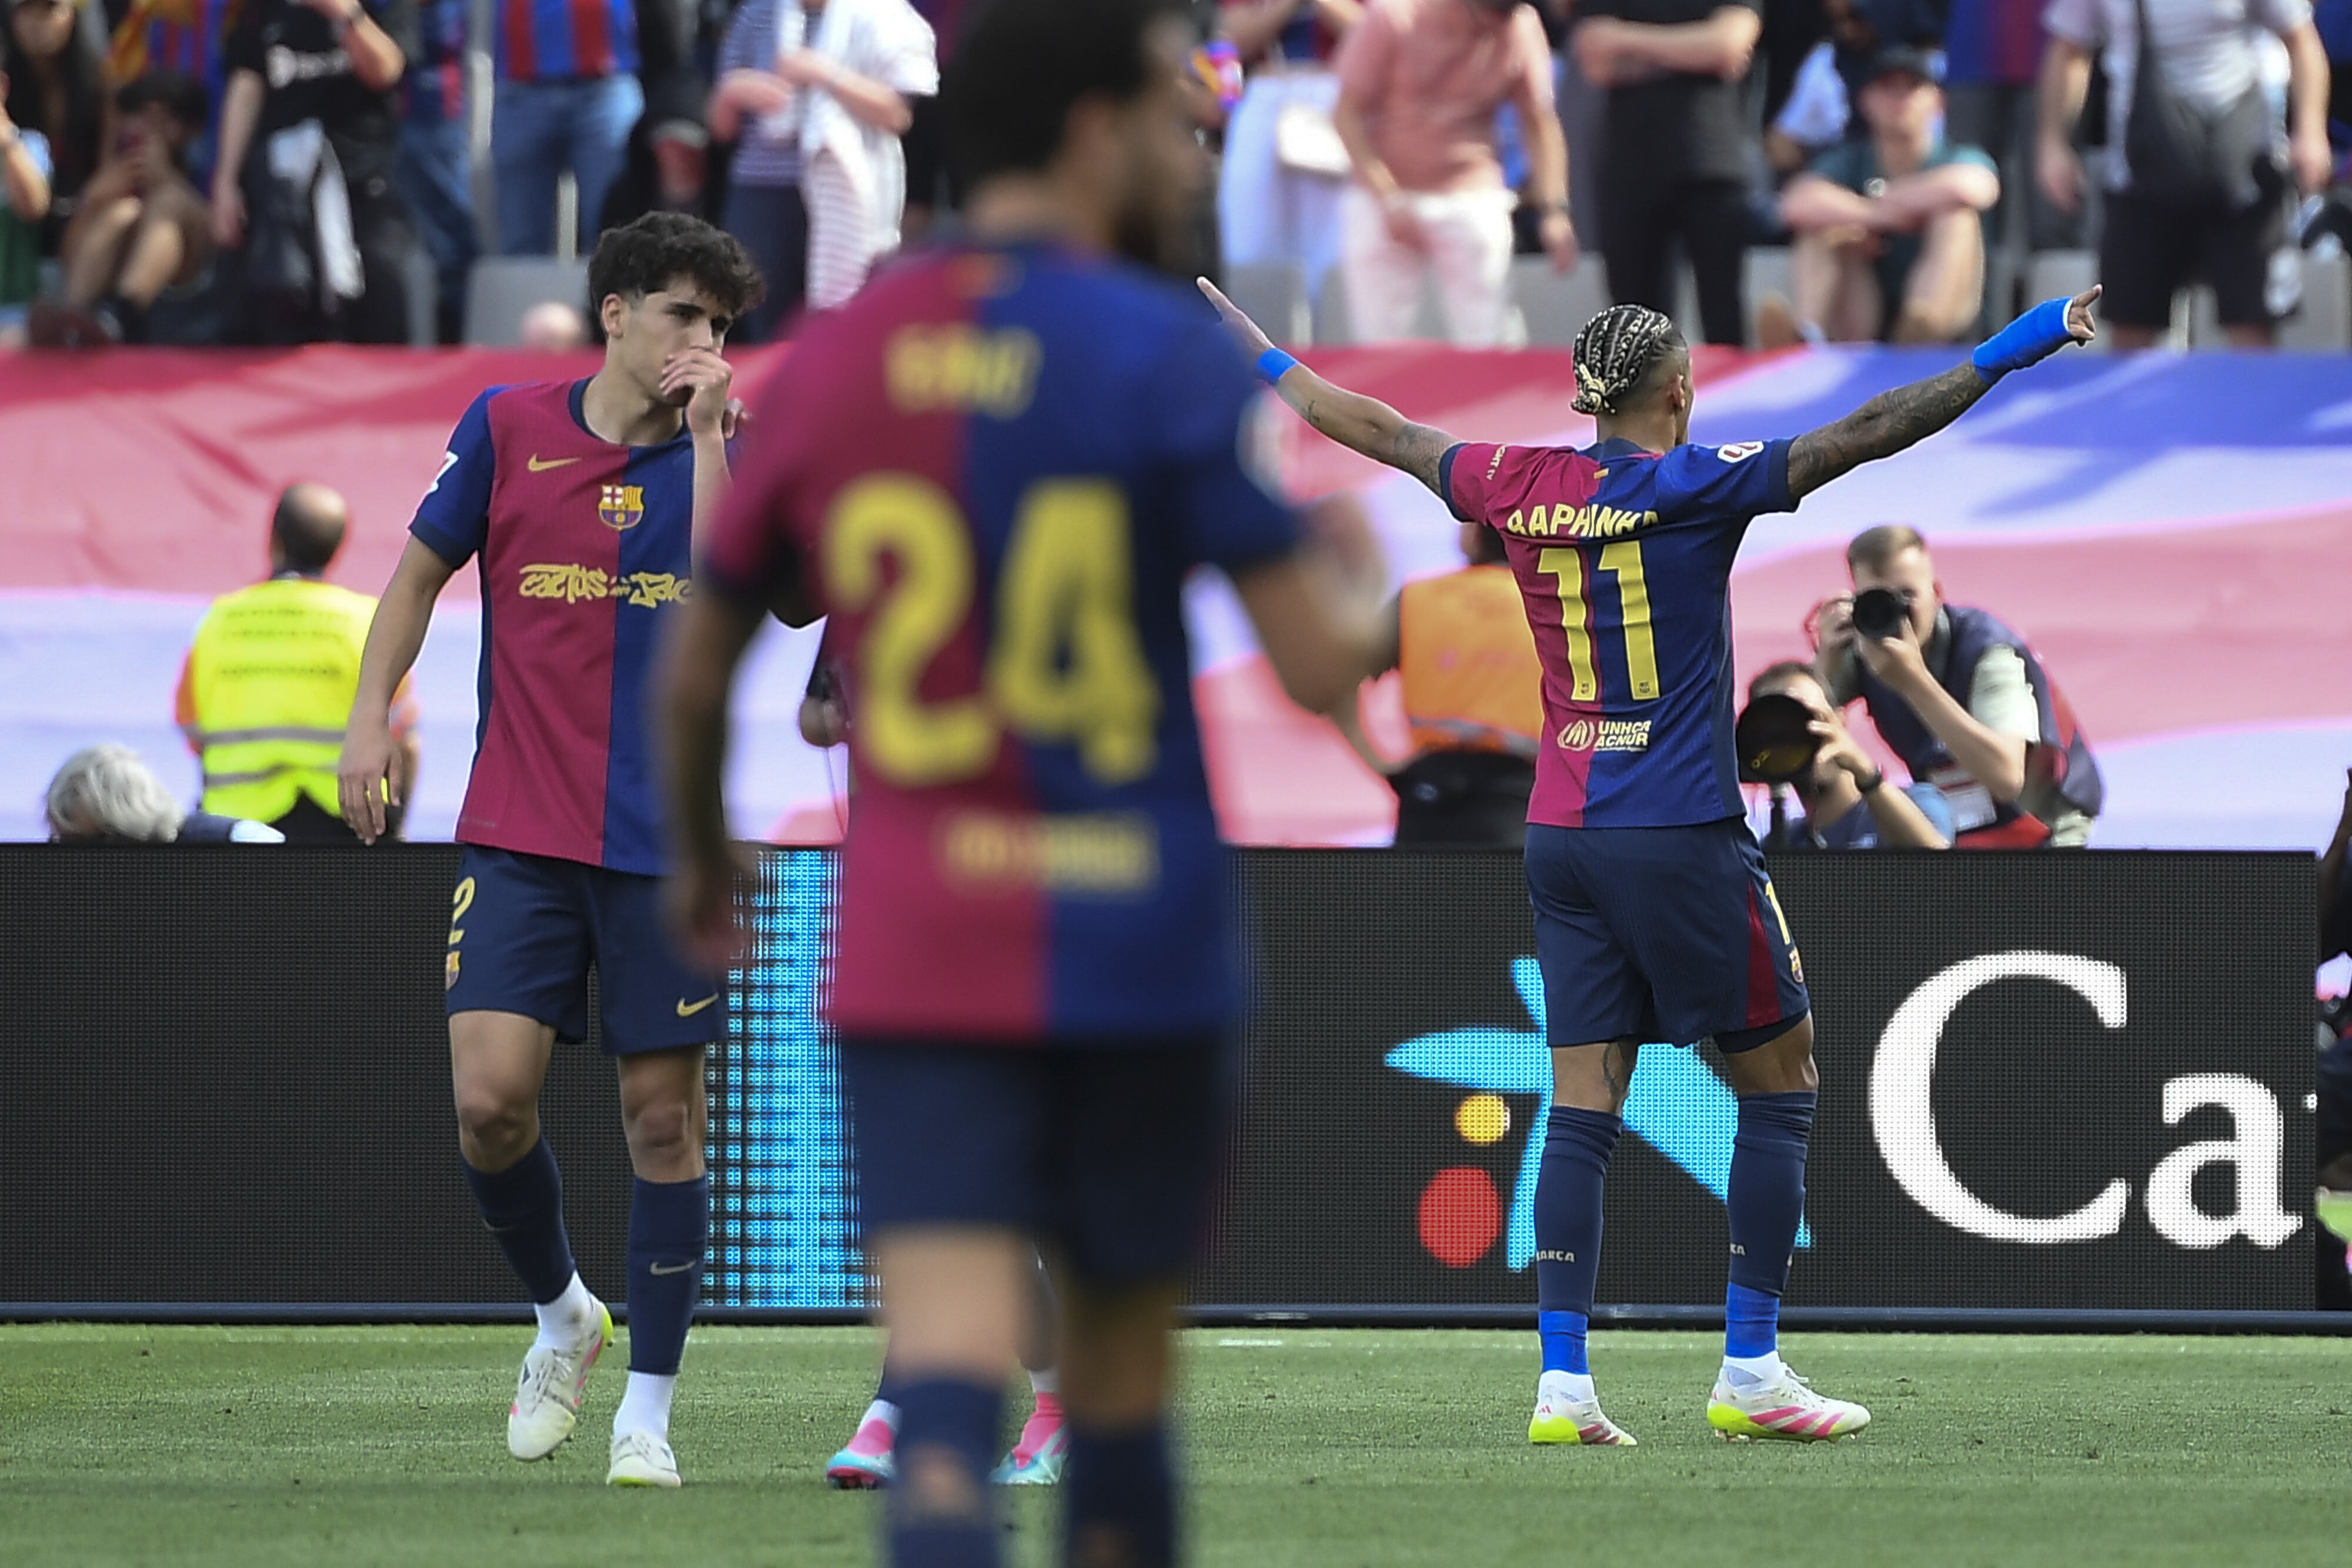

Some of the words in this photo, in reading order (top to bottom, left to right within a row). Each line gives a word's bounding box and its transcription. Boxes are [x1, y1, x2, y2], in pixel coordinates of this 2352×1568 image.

[828, 475, 1155, 787] 24
[1537, 540, 1660, 701] 11
[1595, 732, 1648, 747] ACNUR
[1598, 720, 1652, 735] UNHCR
[1867, 950, 2317, 1250] Ca
